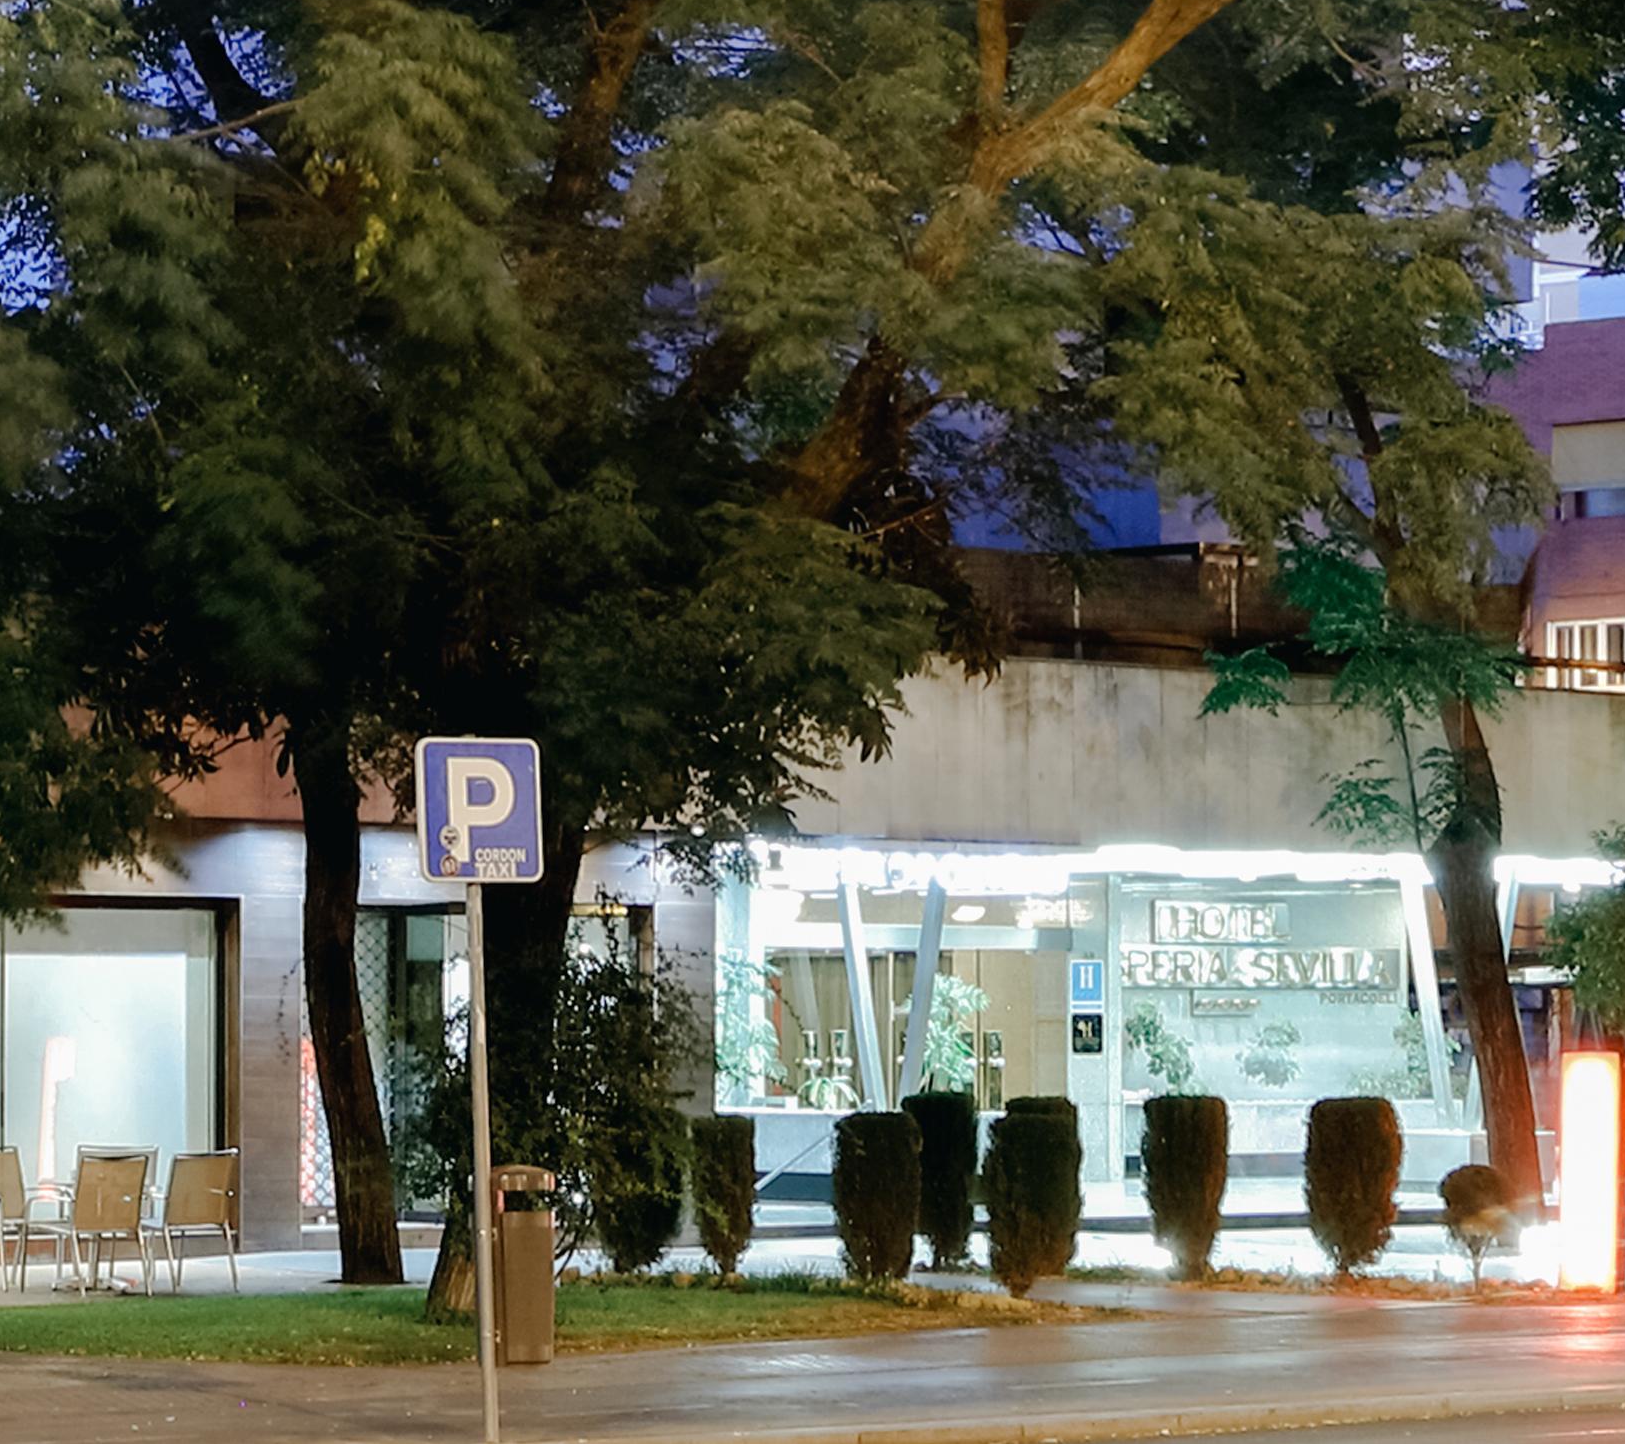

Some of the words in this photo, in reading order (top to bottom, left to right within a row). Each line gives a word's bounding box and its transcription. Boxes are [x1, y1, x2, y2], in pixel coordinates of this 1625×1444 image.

[447, 756, 515, 862] P
[474, 848, 526, 863] CORDON
[474, 862, 517, 878] TAXI
[1158, 905, 1290, 940] HOTEL
